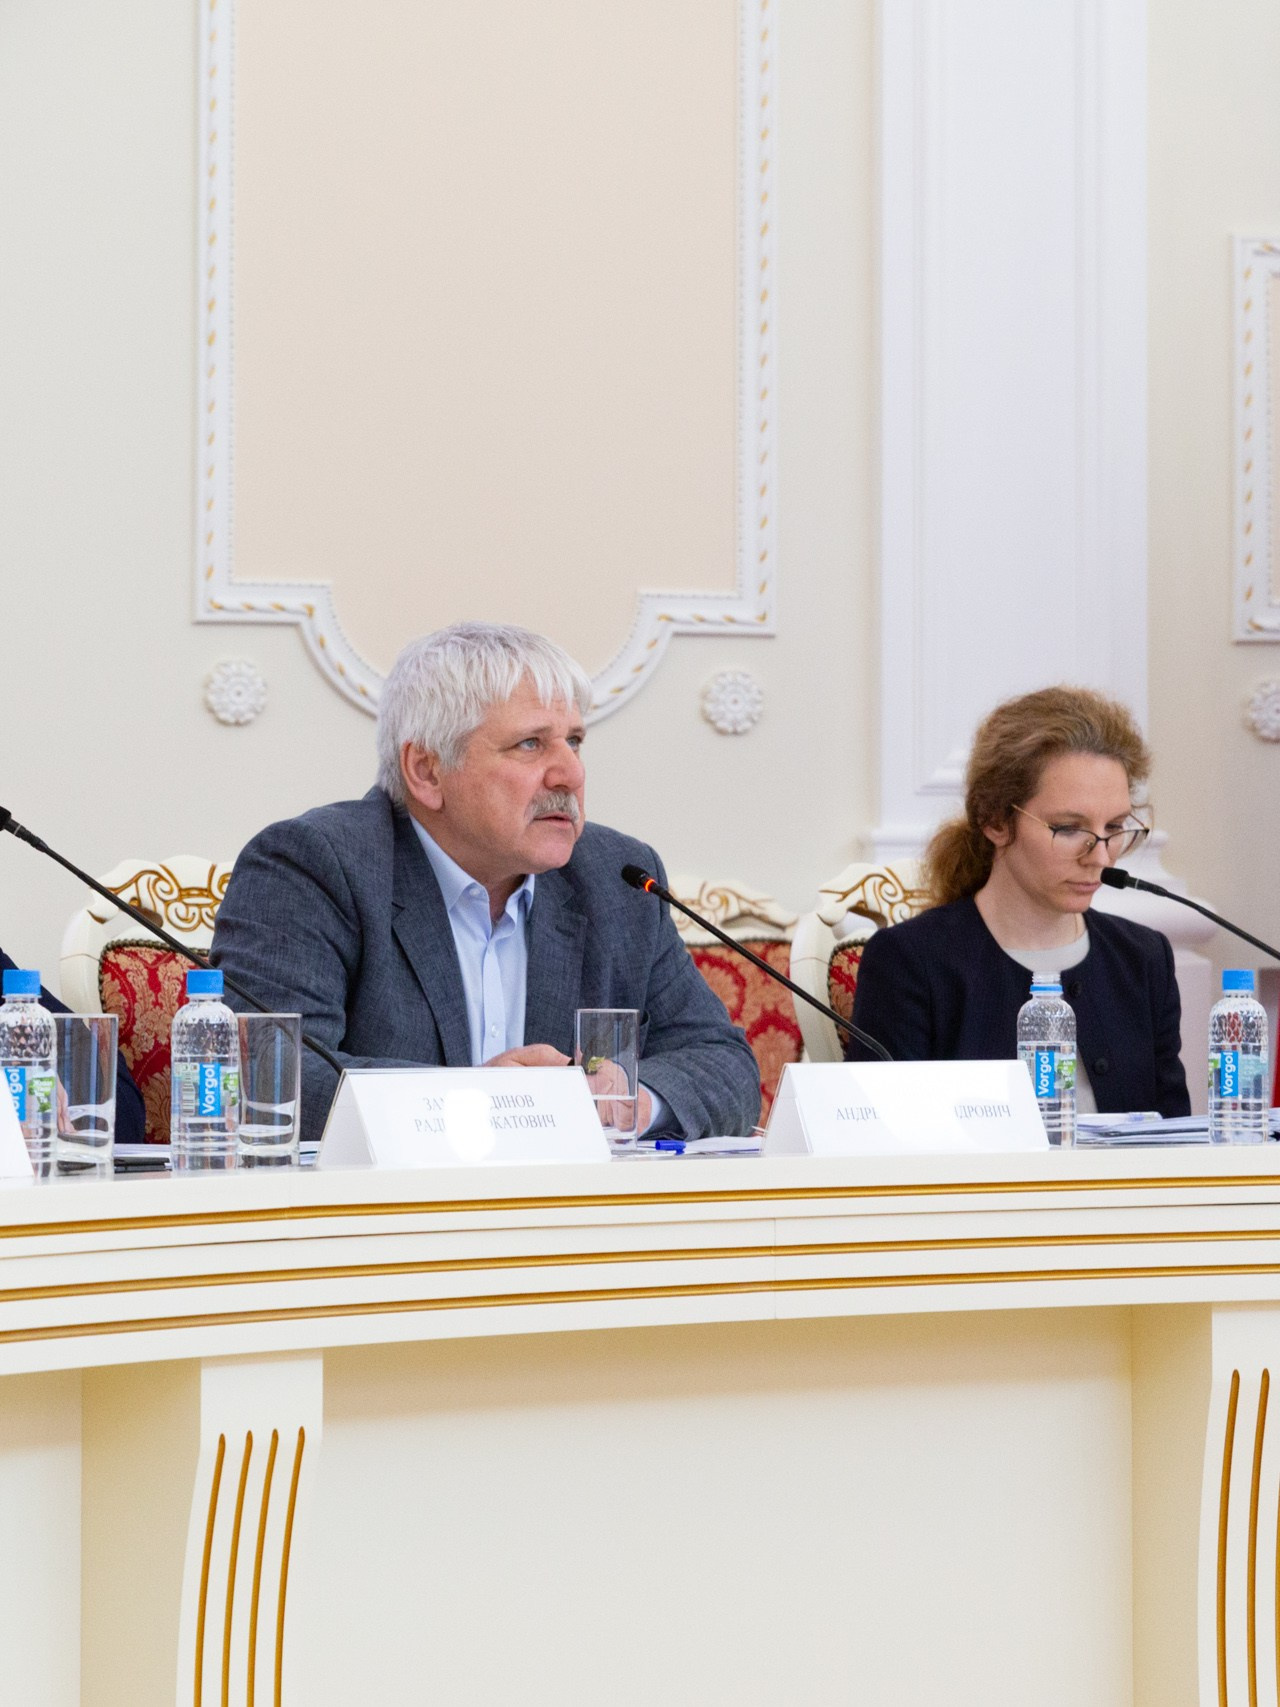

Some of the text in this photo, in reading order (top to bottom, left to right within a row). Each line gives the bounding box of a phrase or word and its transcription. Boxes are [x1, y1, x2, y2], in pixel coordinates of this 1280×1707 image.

[7, 1069, 23, 1117] orgol
[202, 1064, 218, 1114] Vorgol
[1037, 1052, 1052, 1095] Vorgol
[1222, 1052, 1236, 1095] Vorgol
